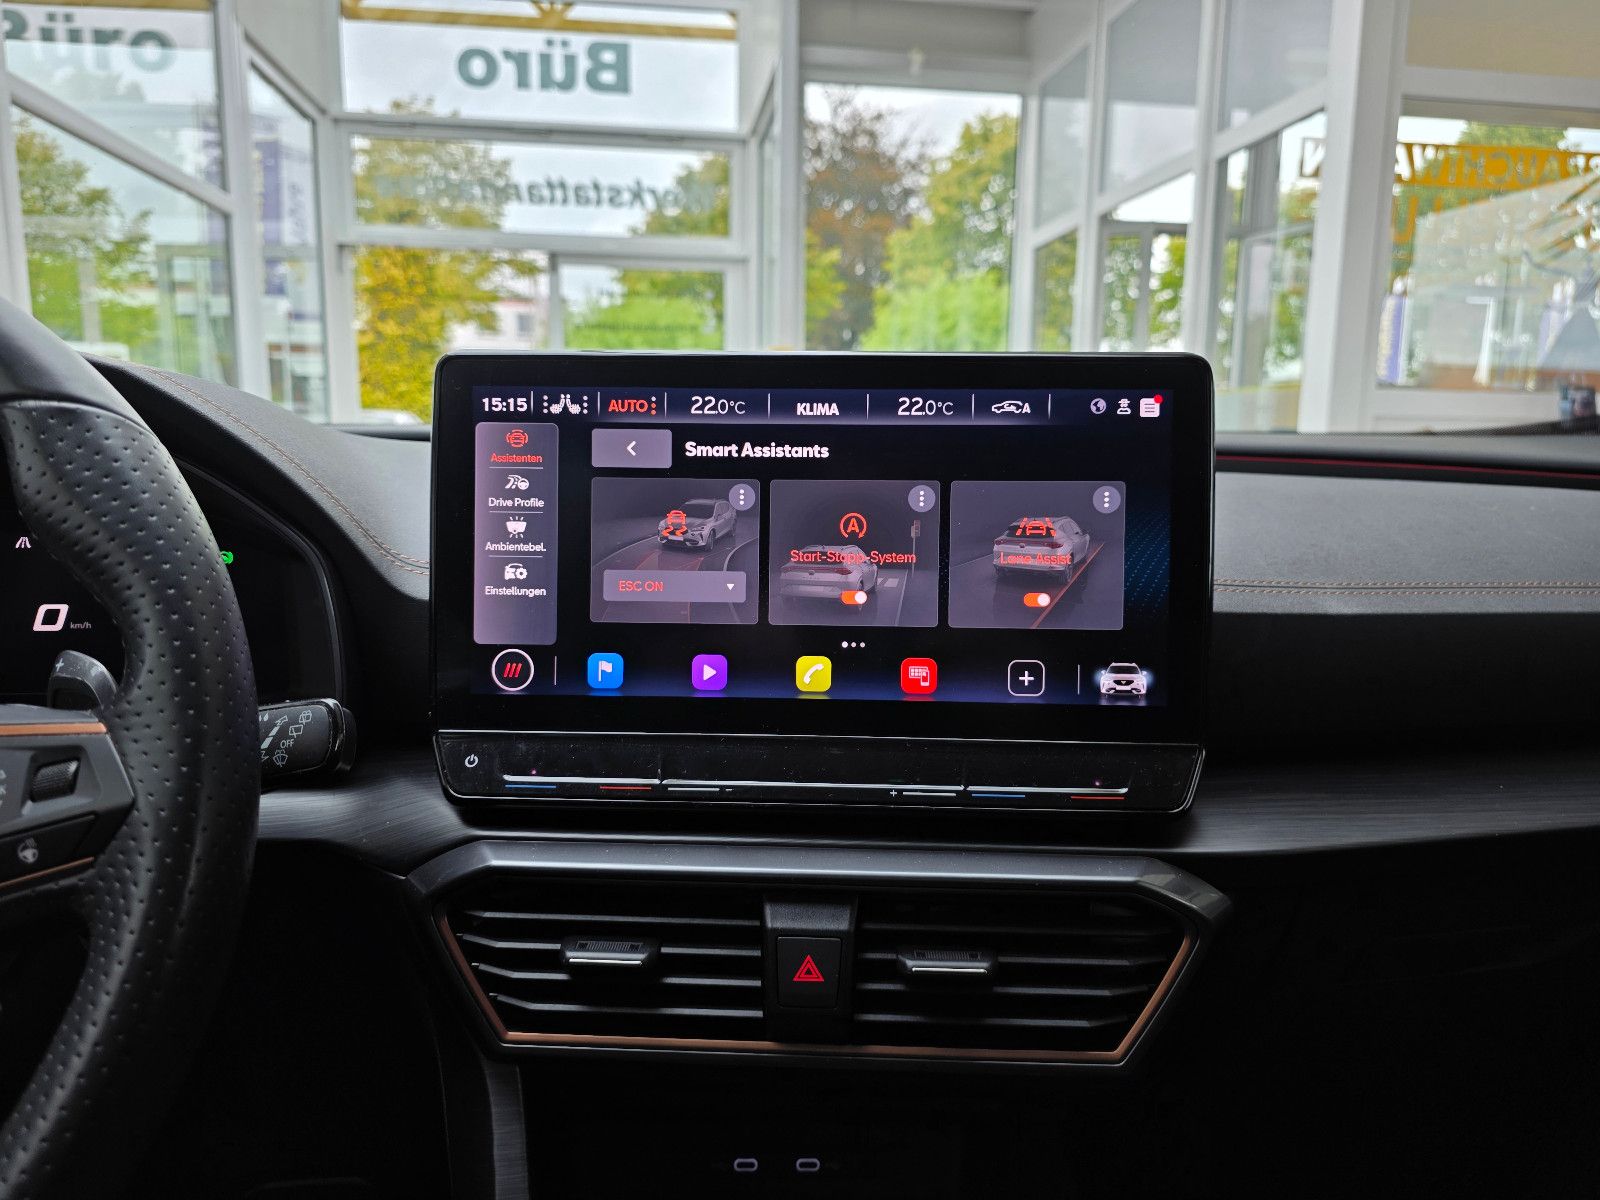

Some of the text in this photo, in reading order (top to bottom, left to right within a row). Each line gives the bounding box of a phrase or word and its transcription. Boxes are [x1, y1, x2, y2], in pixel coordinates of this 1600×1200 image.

[482, 397, 528, 412] 15:15
[608, 399, 648, 413] AUTO
[796, 402, 840, 416] KLIMA
[684, 441, 830, 458] Smart Assistants
[490, 452, 543, 463] Assistenten
[488, 497, 545, 508] Drive Profile
[485, 541, 547, 552] Ambientebel.
[790, 550, 917, 565] Start-Stopp-System
[1000, 552, 1072, 565] Lane Assist
[485, 585, 547, 598] Einstellungen
[618, 579, 664, 592] ESC ON
[33, 603, 92, 631] 0 km/h
[280, 738, 295, 748] OFF
